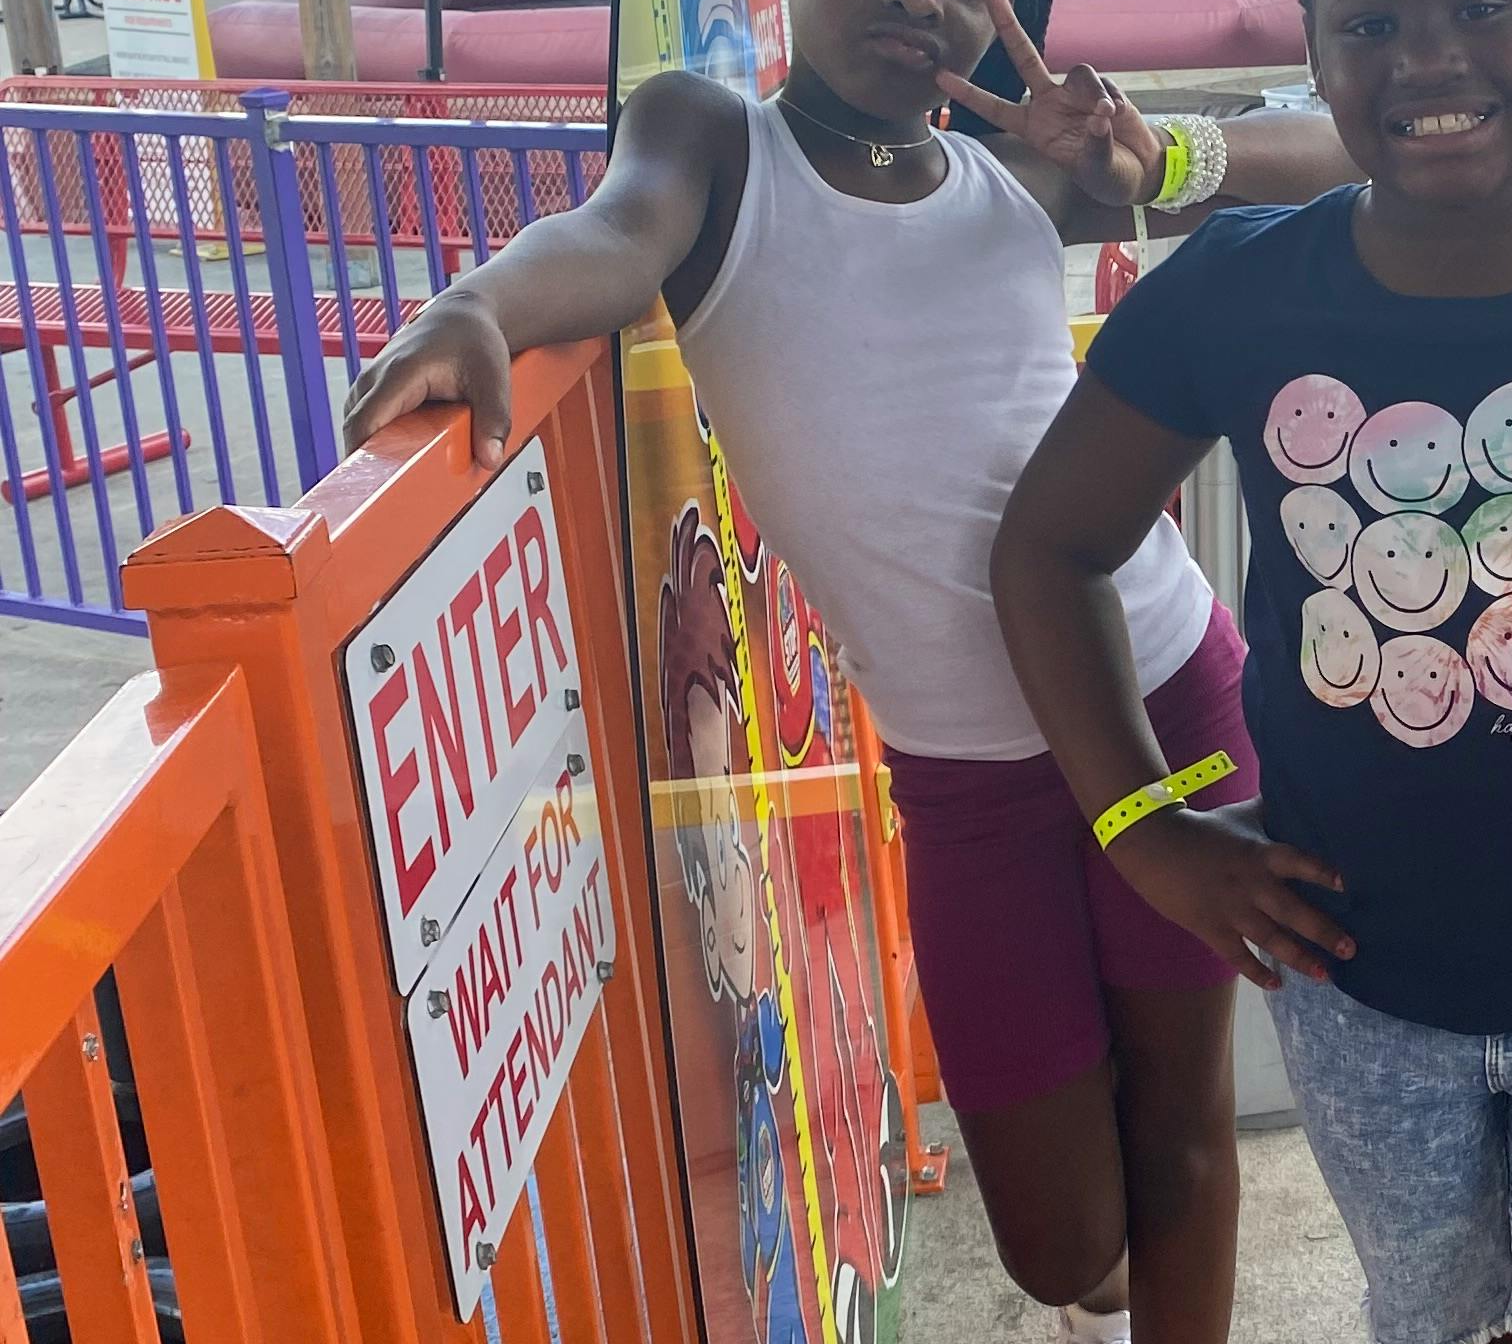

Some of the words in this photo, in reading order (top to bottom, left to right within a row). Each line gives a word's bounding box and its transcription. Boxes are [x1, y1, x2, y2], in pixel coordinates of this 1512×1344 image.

[368, 506, 568, 920] ENTER
[446, 864, 523, 1081] WAIT
[524, 769, 582, 931] FOR
[457, 857, 606, 1273] ATTENDANT
